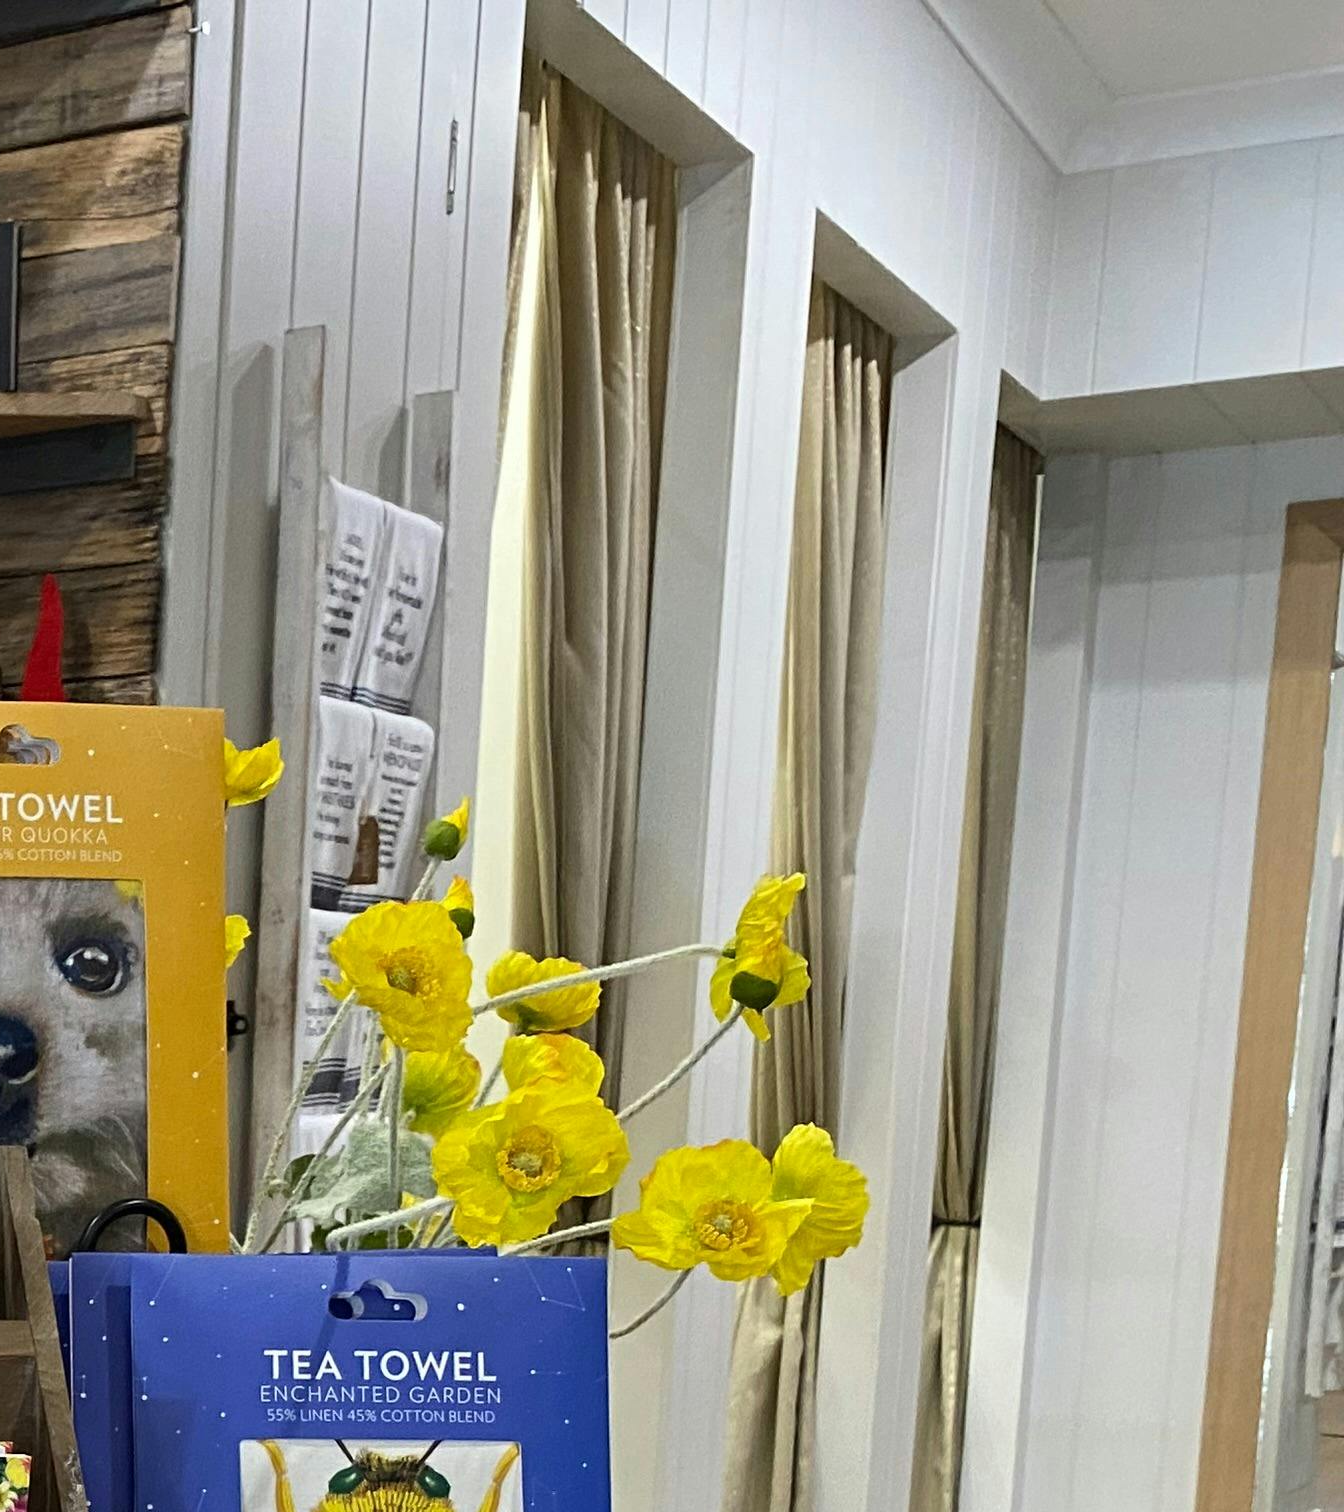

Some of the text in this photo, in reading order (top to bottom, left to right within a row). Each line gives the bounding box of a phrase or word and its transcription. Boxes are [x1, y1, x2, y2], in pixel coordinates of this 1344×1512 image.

[20, 826, 109, 845] QUOKKA
[17, 848, 77, 862] COTTON
[79, 850, 123, 863] BLEND
[263, 1349, 498, 1382] TEA TOWEL
[260, 1385, 502, 1404] ENCHANTED GARDEN
[267, 1408, 496, 1424] 55% LINEN 45% COTTON BLEND
